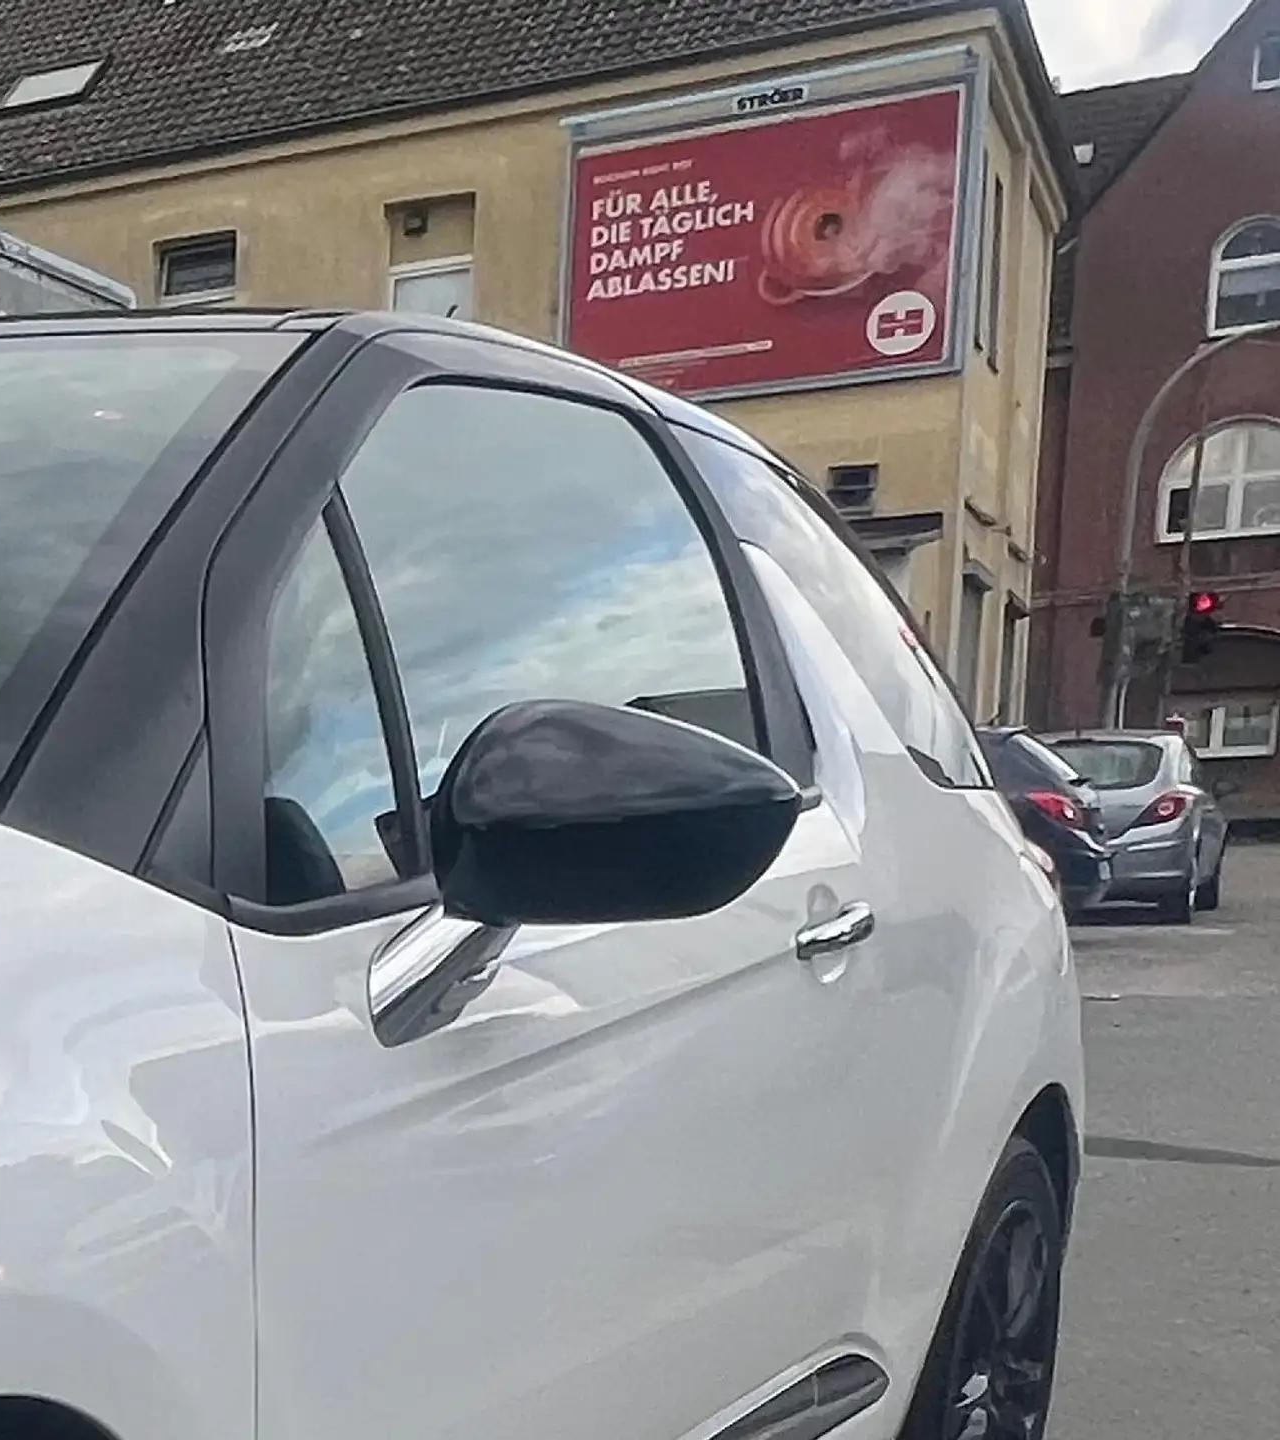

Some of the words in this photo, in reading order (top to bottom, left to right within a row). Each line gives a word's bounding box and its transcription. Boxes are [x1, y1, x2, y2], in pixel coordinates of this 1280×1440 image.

[592, 189, 642, 221] FÜR
[649, 180, 718, 211] ALLE,
[591, 220, 632, 248] DIE
[640, 200, 755, 239] TÄGLICH
[590, 239, 684, 275] DAMPF
